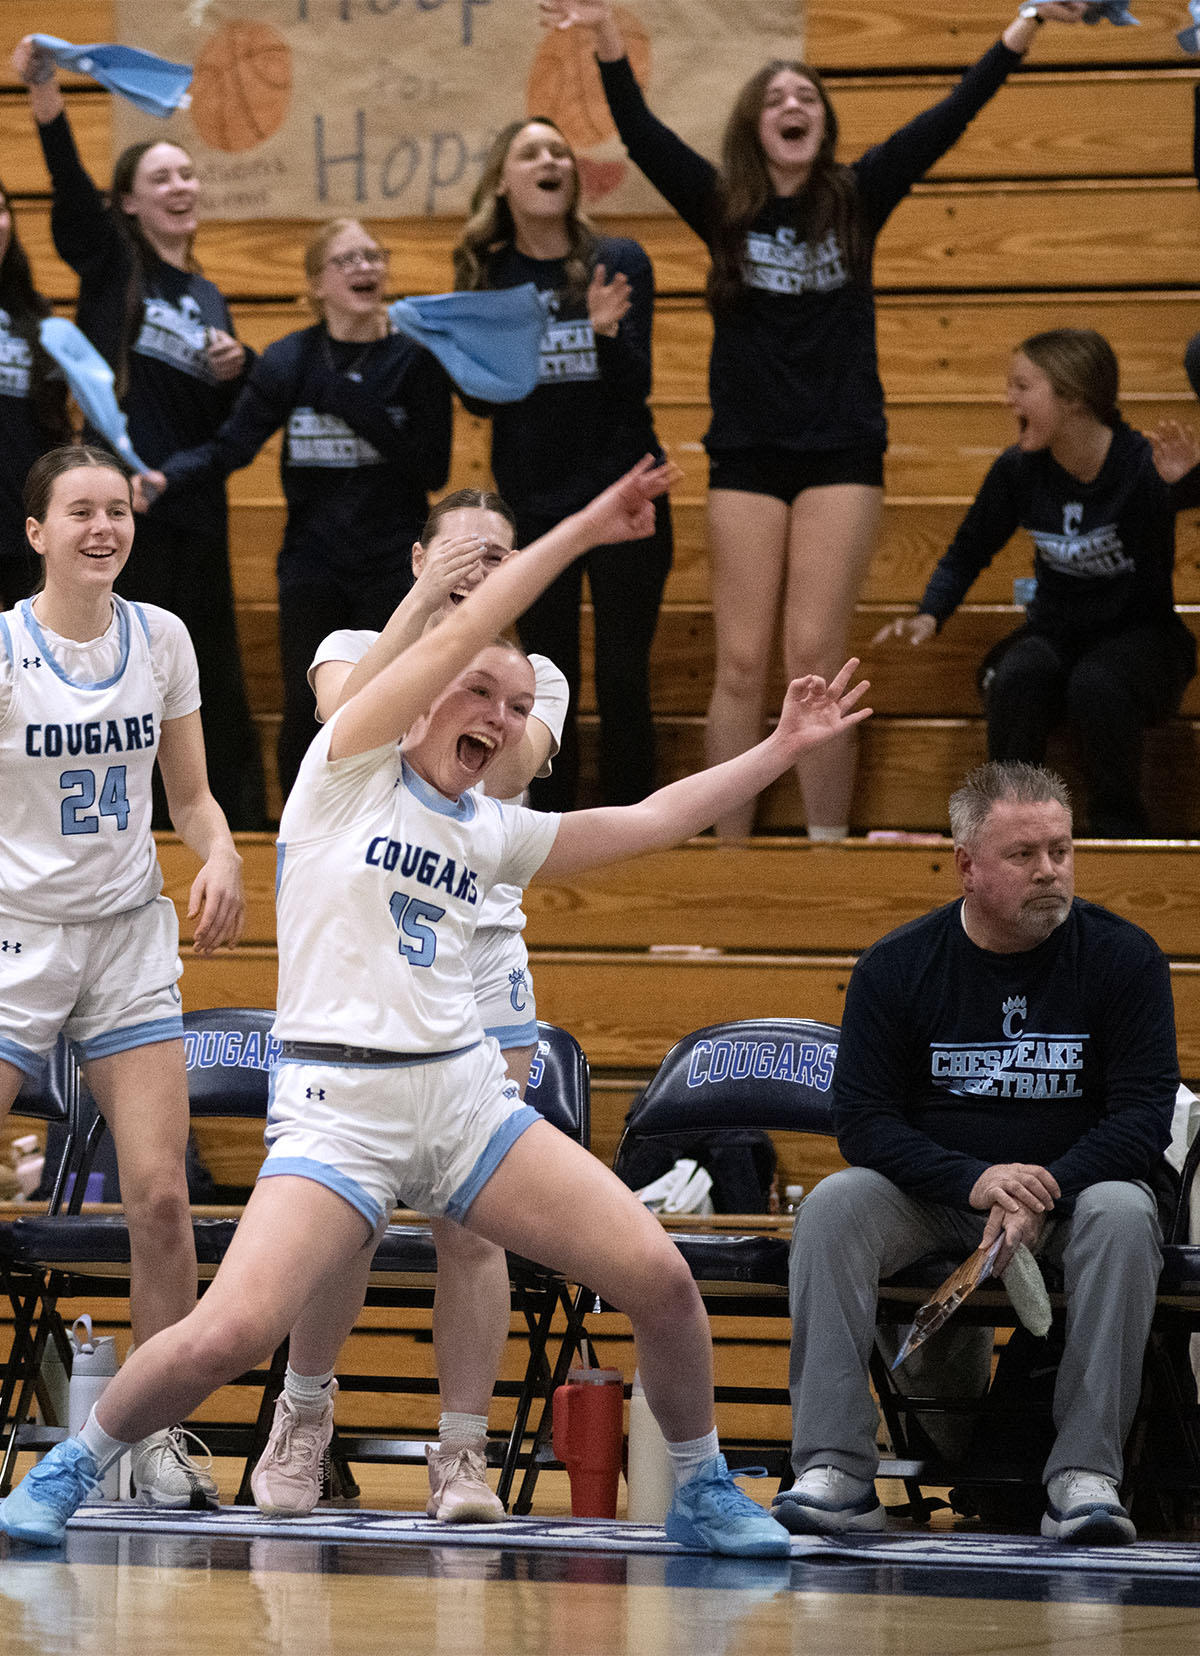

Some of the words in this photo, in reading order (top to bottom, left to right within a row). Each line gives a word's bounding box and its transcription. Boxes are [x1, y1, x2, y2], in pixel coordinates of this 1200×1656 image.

[26, 712, 155, 757] COUGARS
[59, 765, 130, 835] 24
[1002, 1008, 1027, 1039] C
[184, 1031, 284, 1071] OUGAR
[687, 1040, 838, 1092] COUGARS
[931, 1041, 1083, 1077] CHESEAKE
[931, 1072, 1083, 1099] SETBALL
